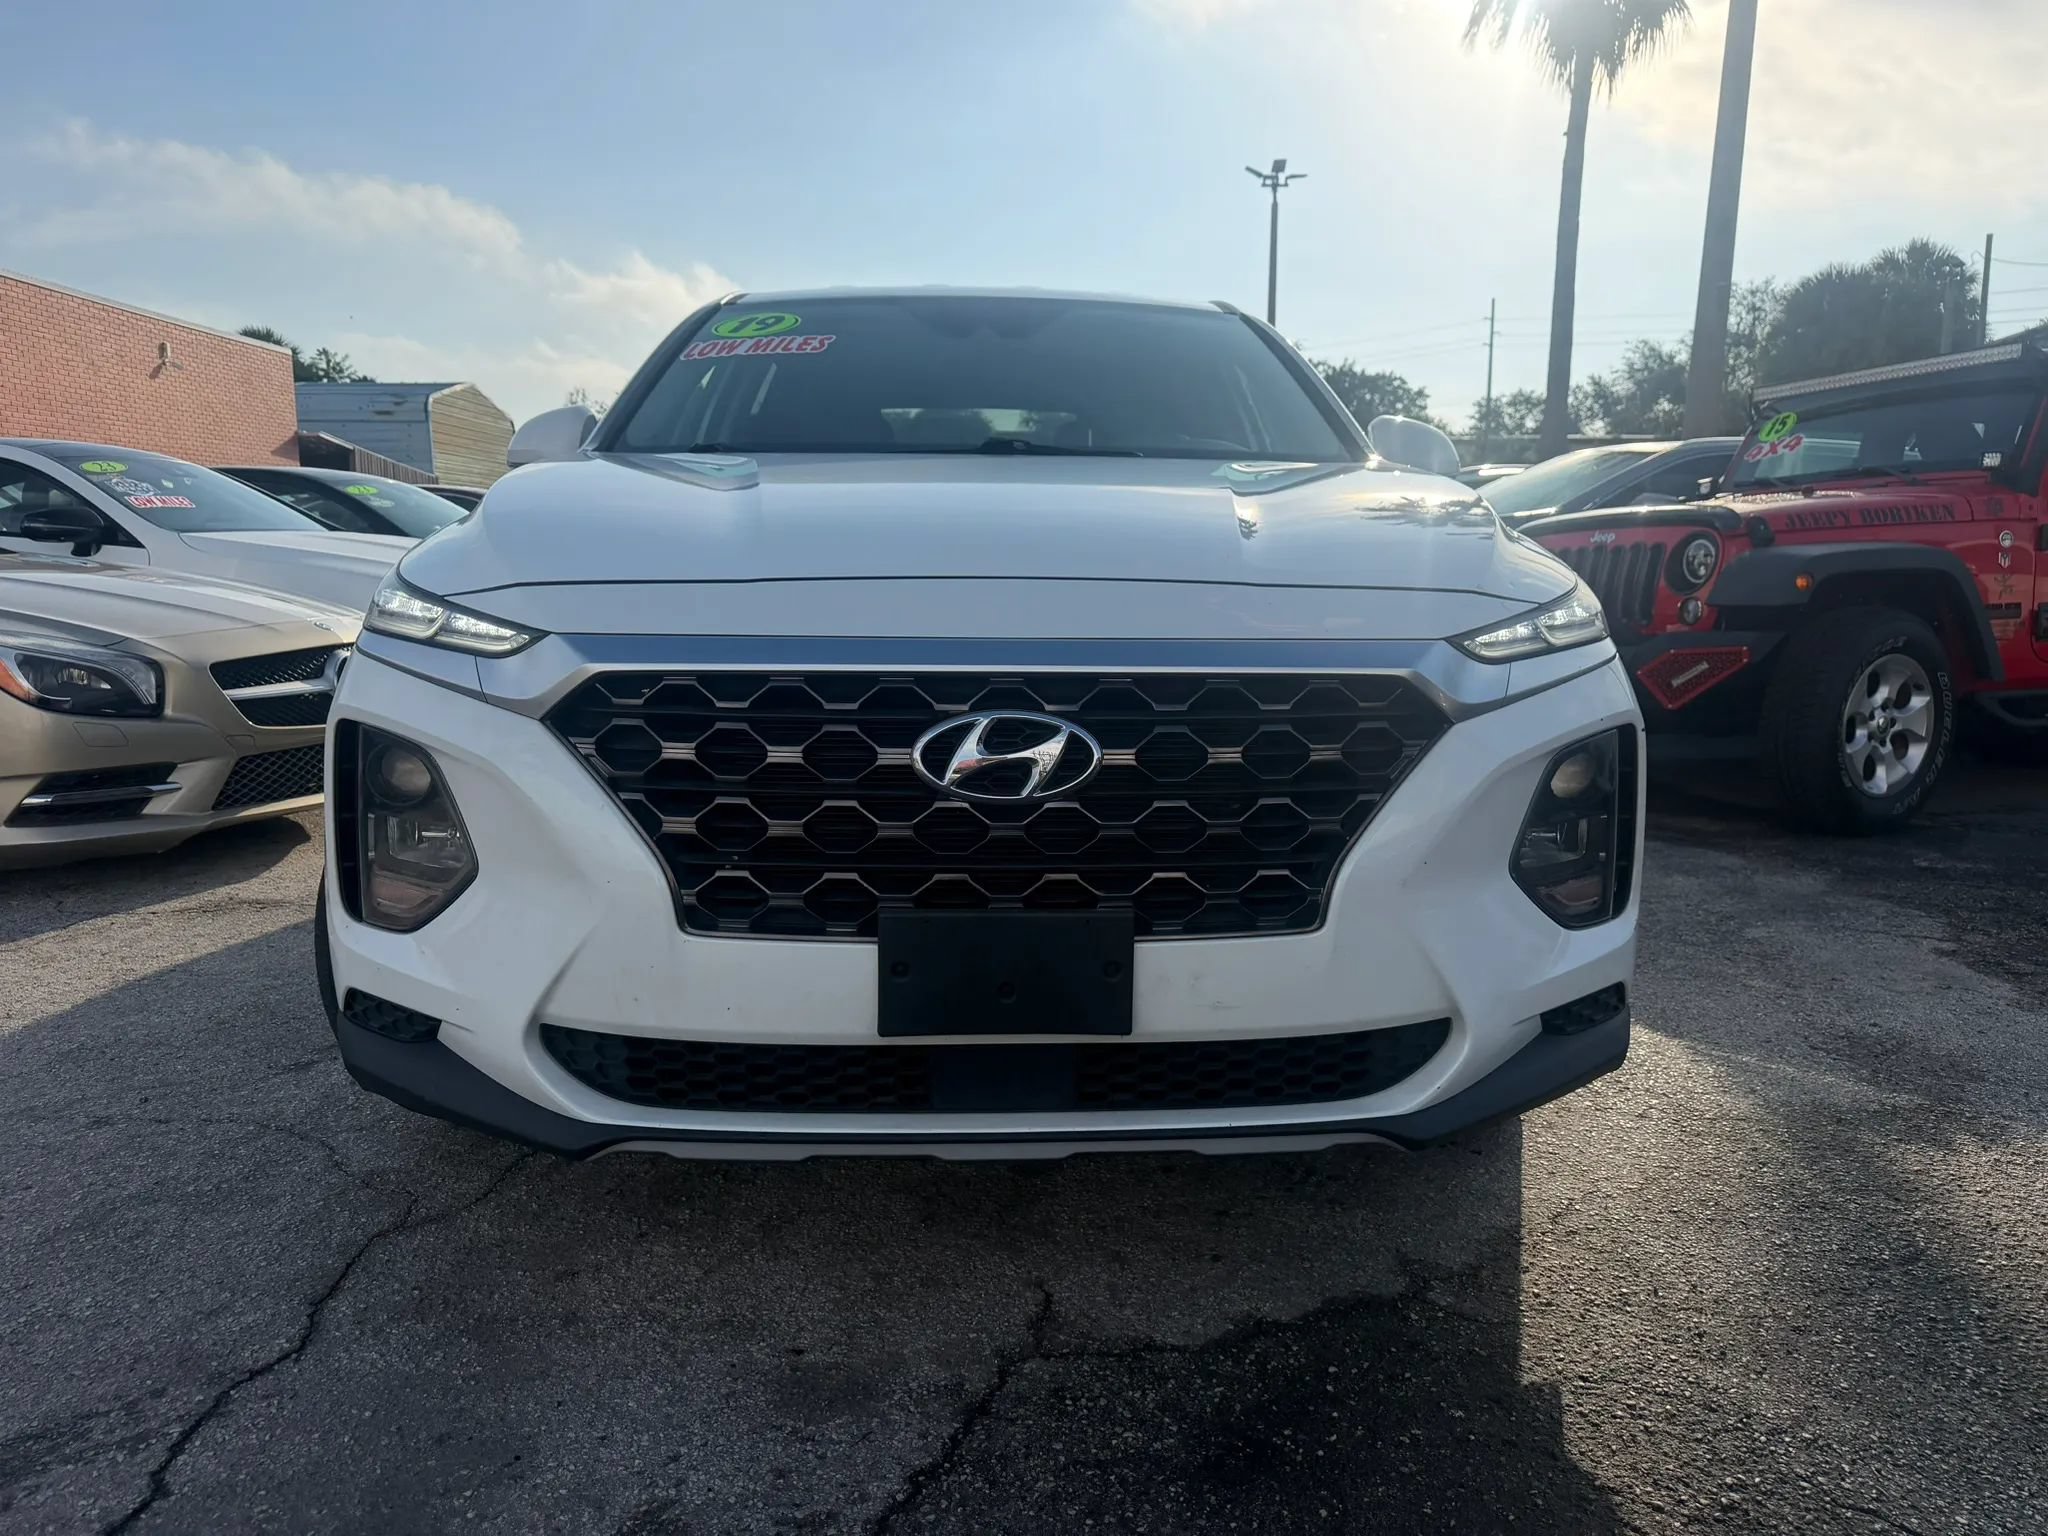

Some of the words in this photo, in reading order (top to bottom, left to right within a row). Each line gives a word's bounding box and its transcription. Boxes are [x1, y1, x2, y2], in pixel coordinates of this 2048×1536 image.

[728, 314, 786, 335] 19
[681, 339, 747, 359] LOW
[744, 335, 835, 354] MILES
[1765, 413, 1792, 438] 15
[127, 496, 158, 508] LOW
[156, 496, 195, 508] MILES
[1785, 510, 1852, 529] JEEPY
[1859, 504, 1956, 524] BORIKEN
[1590, 529, 1616, 544] Jeep
